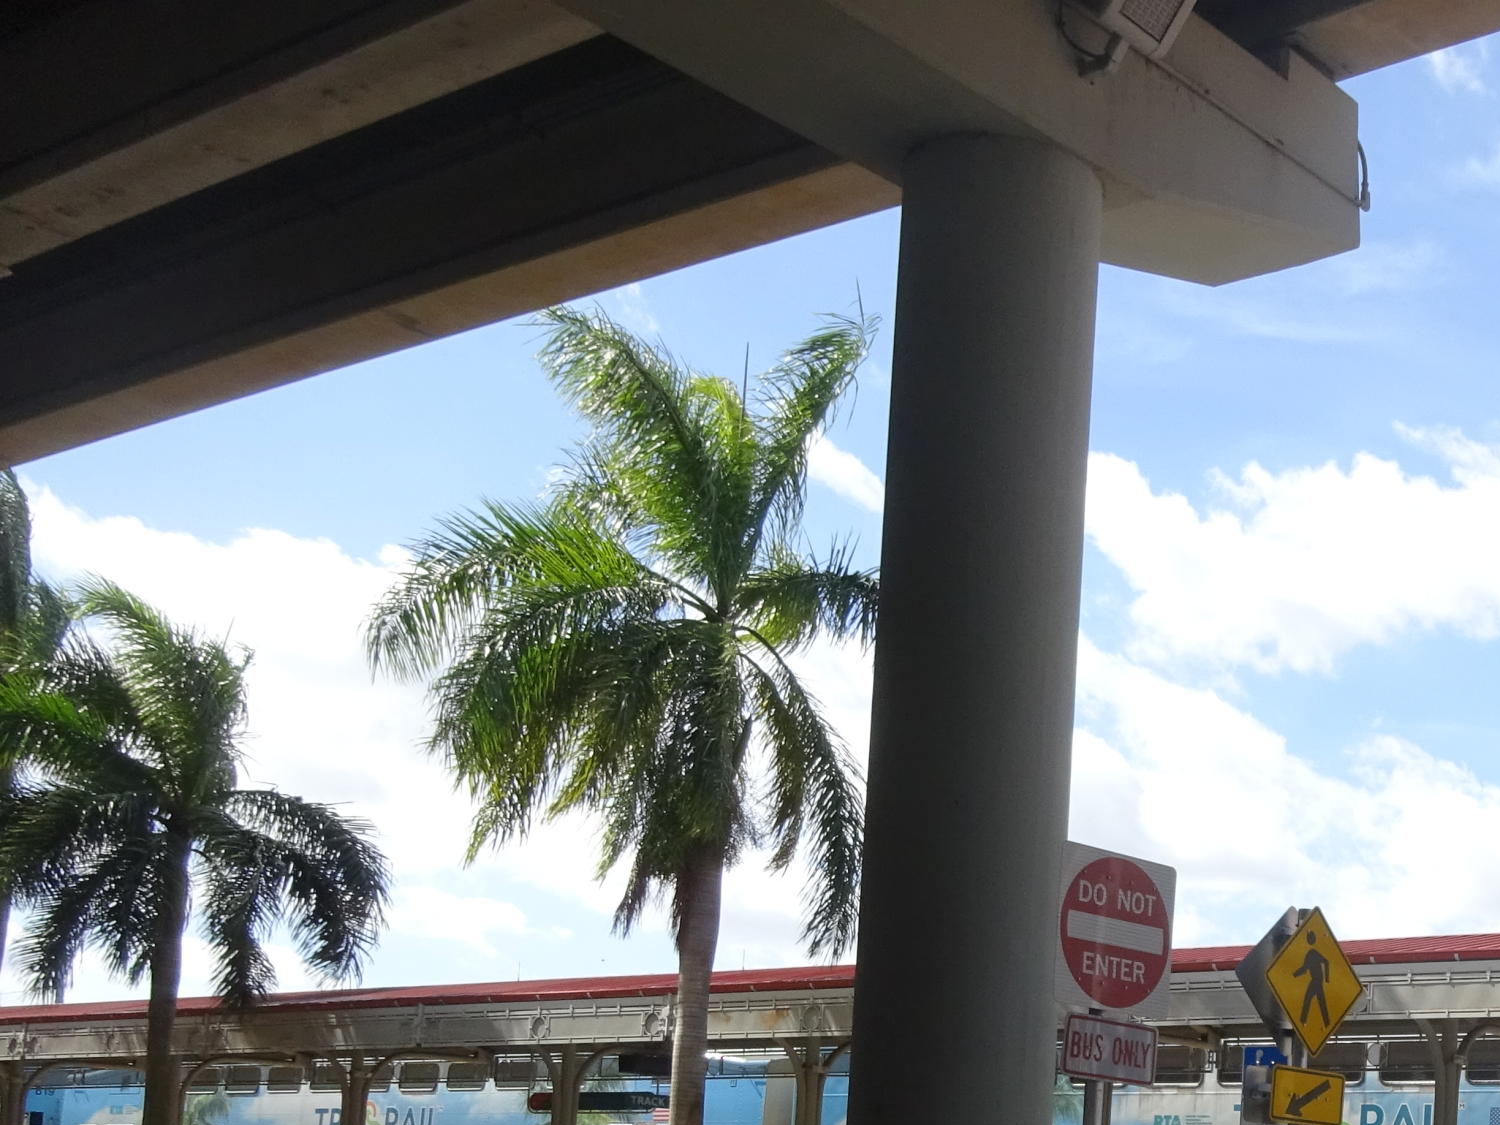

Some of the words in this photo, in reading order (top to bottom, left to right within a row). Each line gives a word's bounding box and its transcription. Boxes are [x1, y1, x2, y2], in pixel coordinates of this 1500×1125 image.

[1079, 879, 1107, 906] DO
[1117, 888, 1157, 917] NOT
[1082, 951, 1146, 985] ENTER
[1070, 1031, 1104, 1062] BUS
[1112, 1036, 1151, 1069] ONLY
[631, 1095, 666, 1107] TRACK
